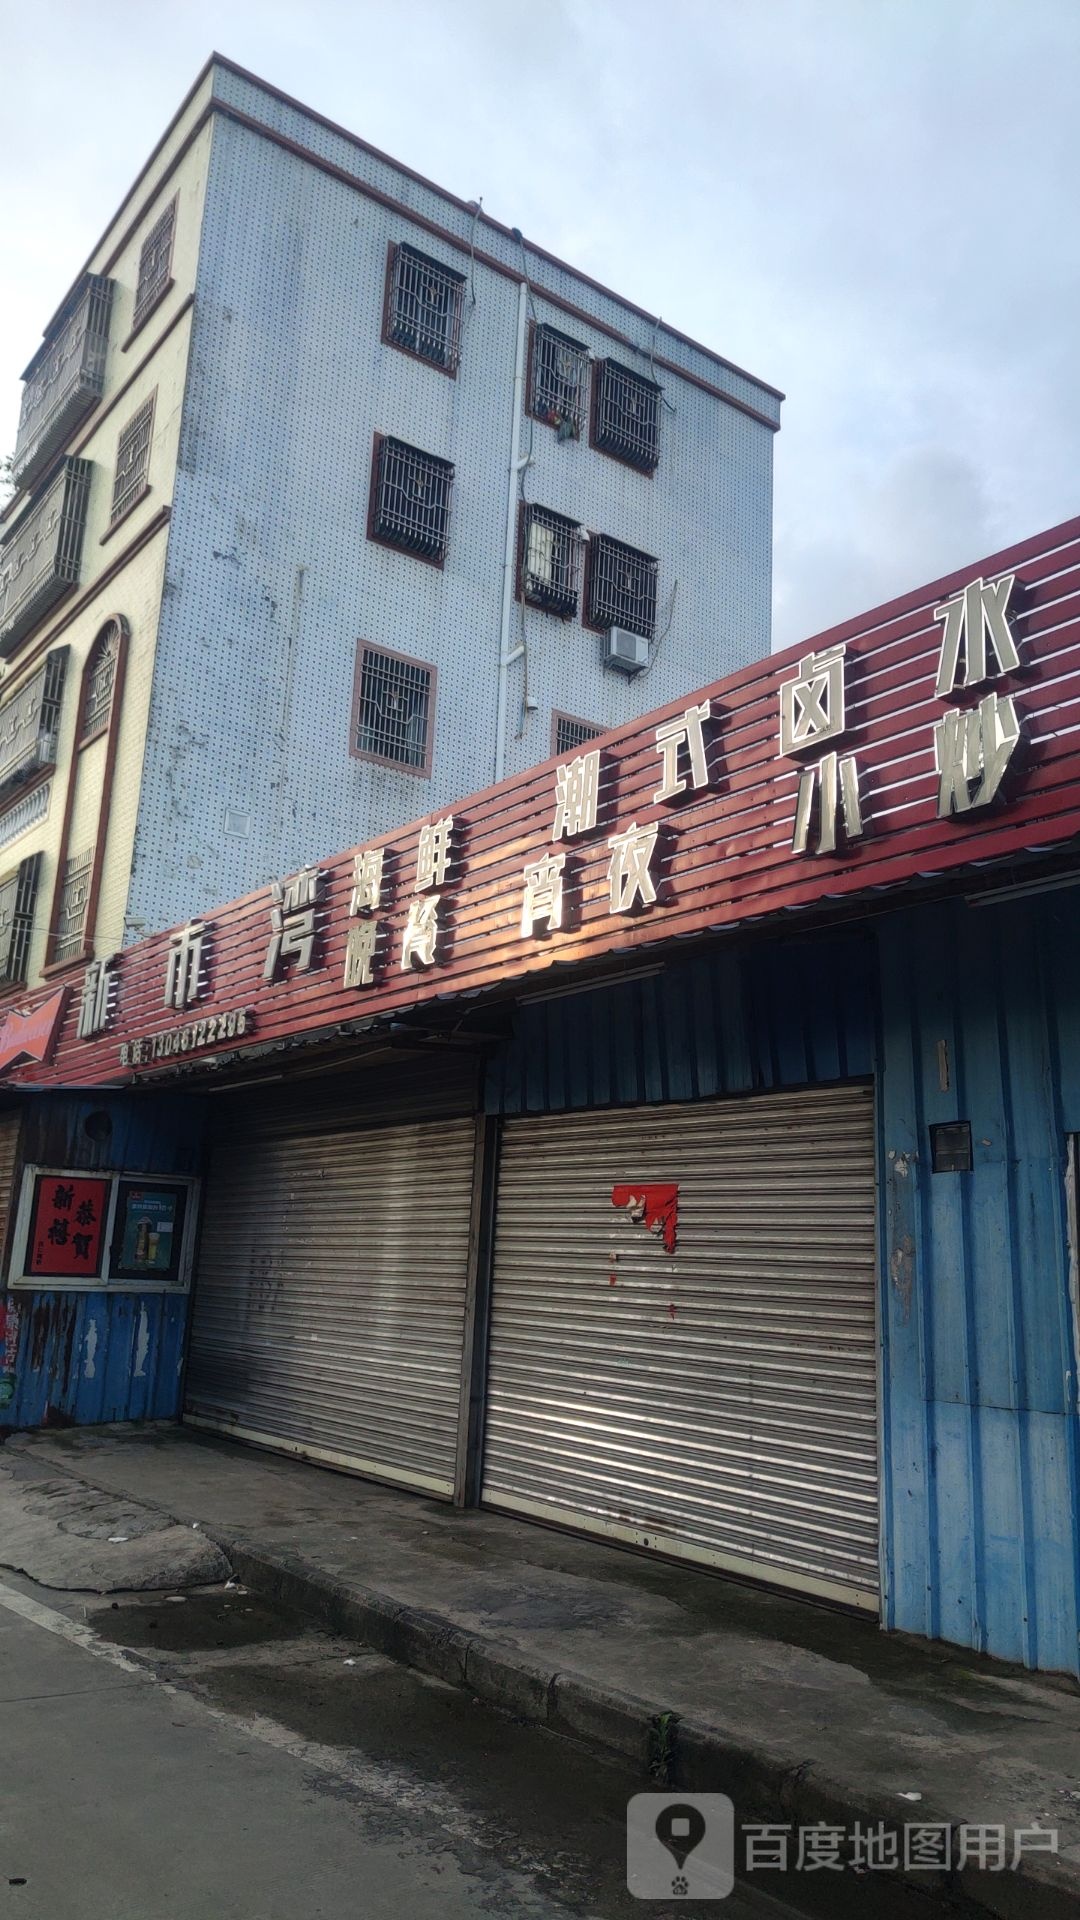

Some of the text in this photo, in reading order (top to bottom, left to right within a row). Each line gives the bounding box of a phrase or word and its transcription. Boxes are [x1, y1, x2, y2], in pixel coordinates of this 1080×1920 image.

[792, 692, 1020, 854] 小炒
[350, 814, 454, 916] 海鲜
[521, 821, 661, 938] 宵夜
